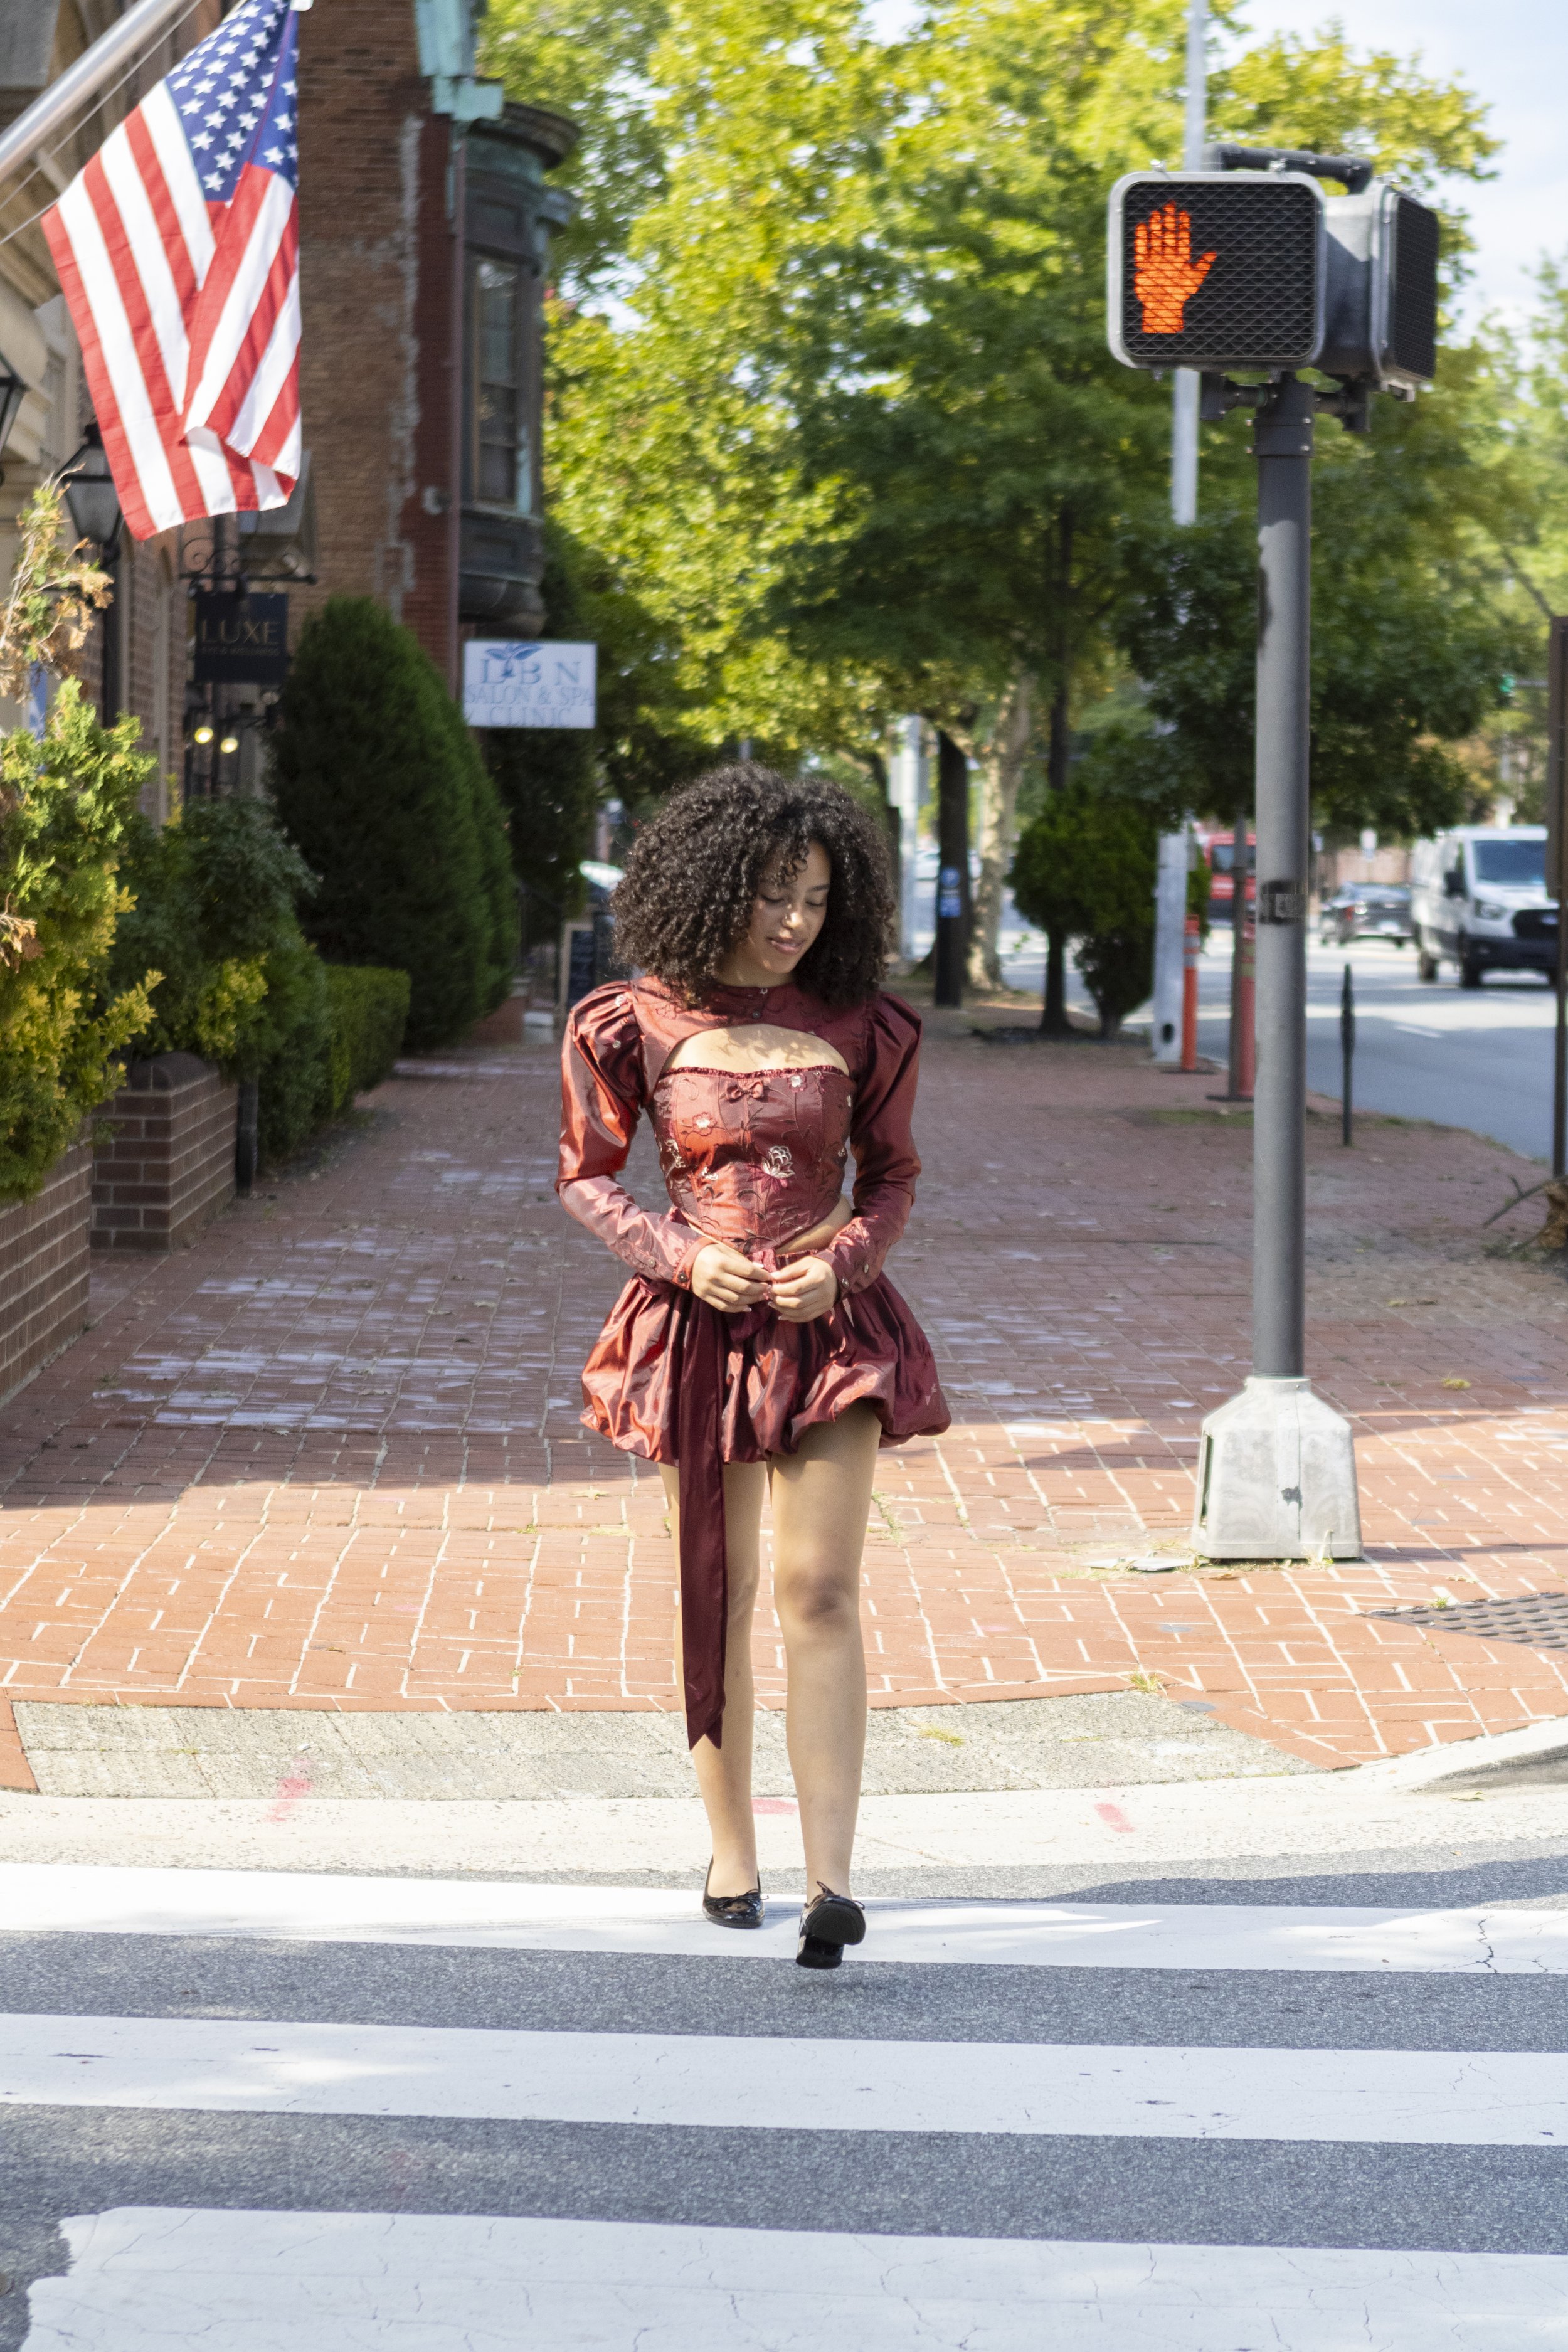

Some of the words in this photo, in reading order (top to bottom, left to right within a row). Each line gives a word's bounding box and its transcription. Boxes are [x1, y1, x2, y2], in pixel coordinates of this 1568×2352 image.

[201, 619, 280, 644] LUXE
[465, 685, 530, 705] SALON
[538, 686, 553, 705] &
[559, 686, 596, 706] SPA
[489, 706, 572, 726] CLINIC
